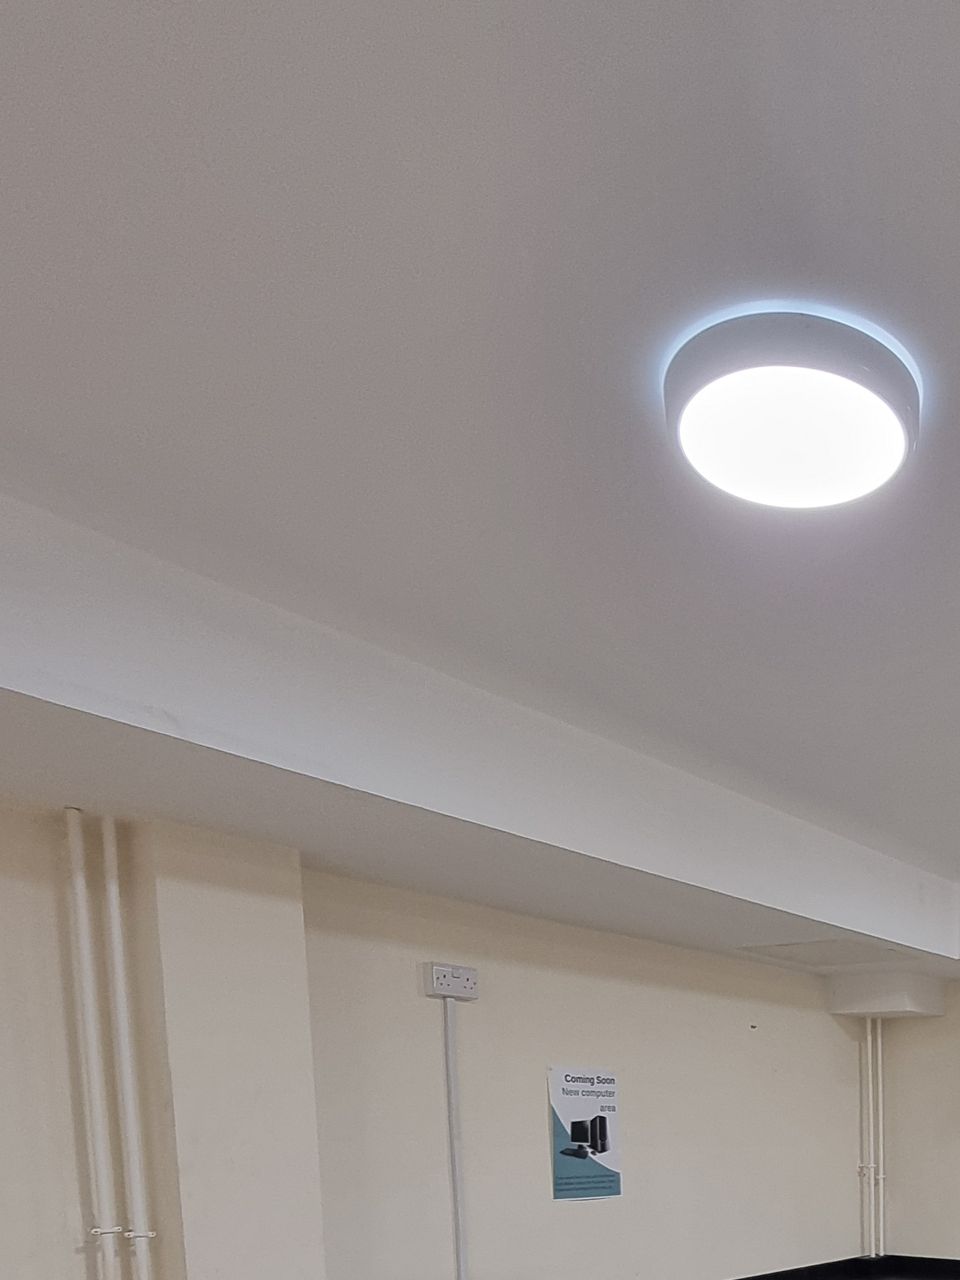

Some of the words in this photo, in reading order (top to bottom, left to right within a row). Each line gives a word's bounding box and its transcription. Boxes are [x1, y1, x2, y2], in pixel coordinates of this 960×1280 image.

[564, 1074, 595, 1086] Coming
[596, 1075, 615, 1085] Soon
[562, 1087, 580, 1096] New
[581, 1089, 615, 1099] computer
[599, 1104, 616, 1112] area
